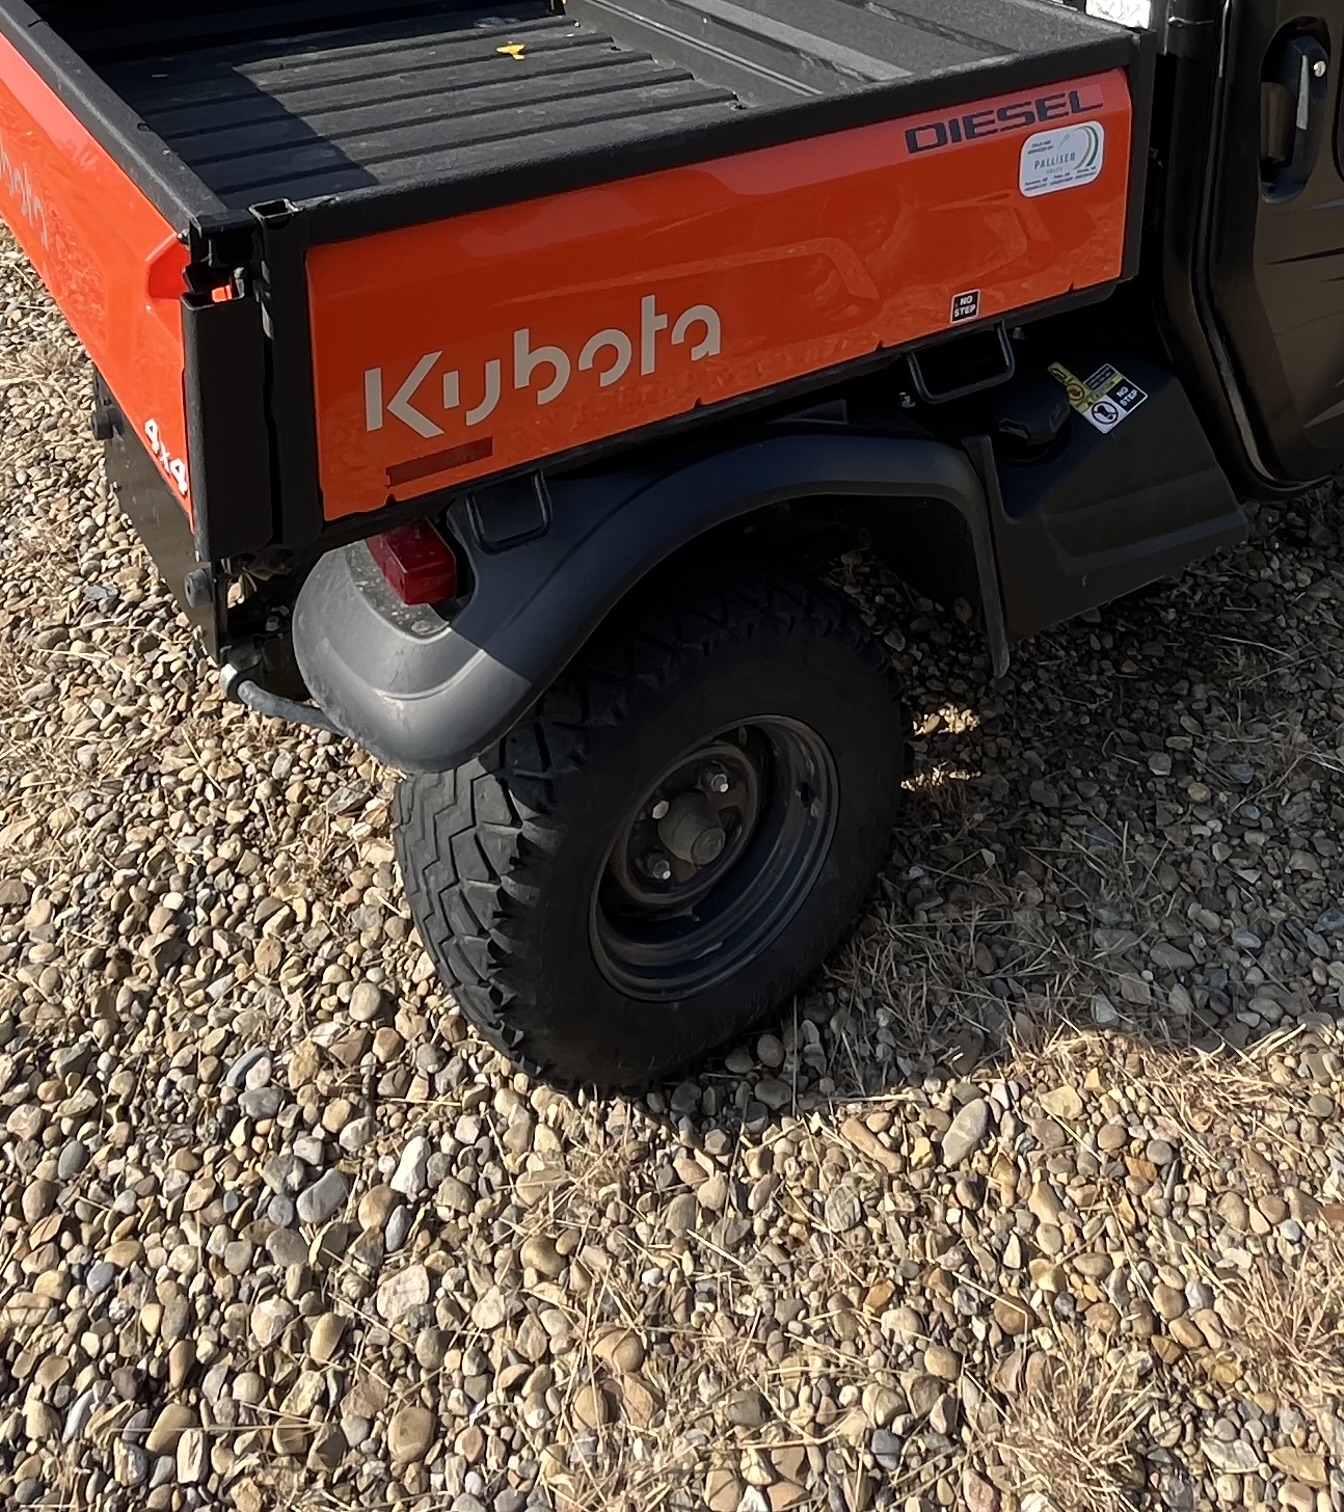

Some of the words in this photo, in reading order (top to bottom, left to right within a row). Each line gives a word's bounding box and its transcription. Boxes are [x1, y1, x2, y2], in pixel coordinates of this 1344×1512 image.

[905, 90, 1104, 154] DIESEL
[959, 295, 973, 306] NO
[954, 303, 976, 318] STEP
[363, 294, 721, 439] Kubota
[1116, 386, 1129, 398] NO
[1119, 388, 1139, 407] STEP
